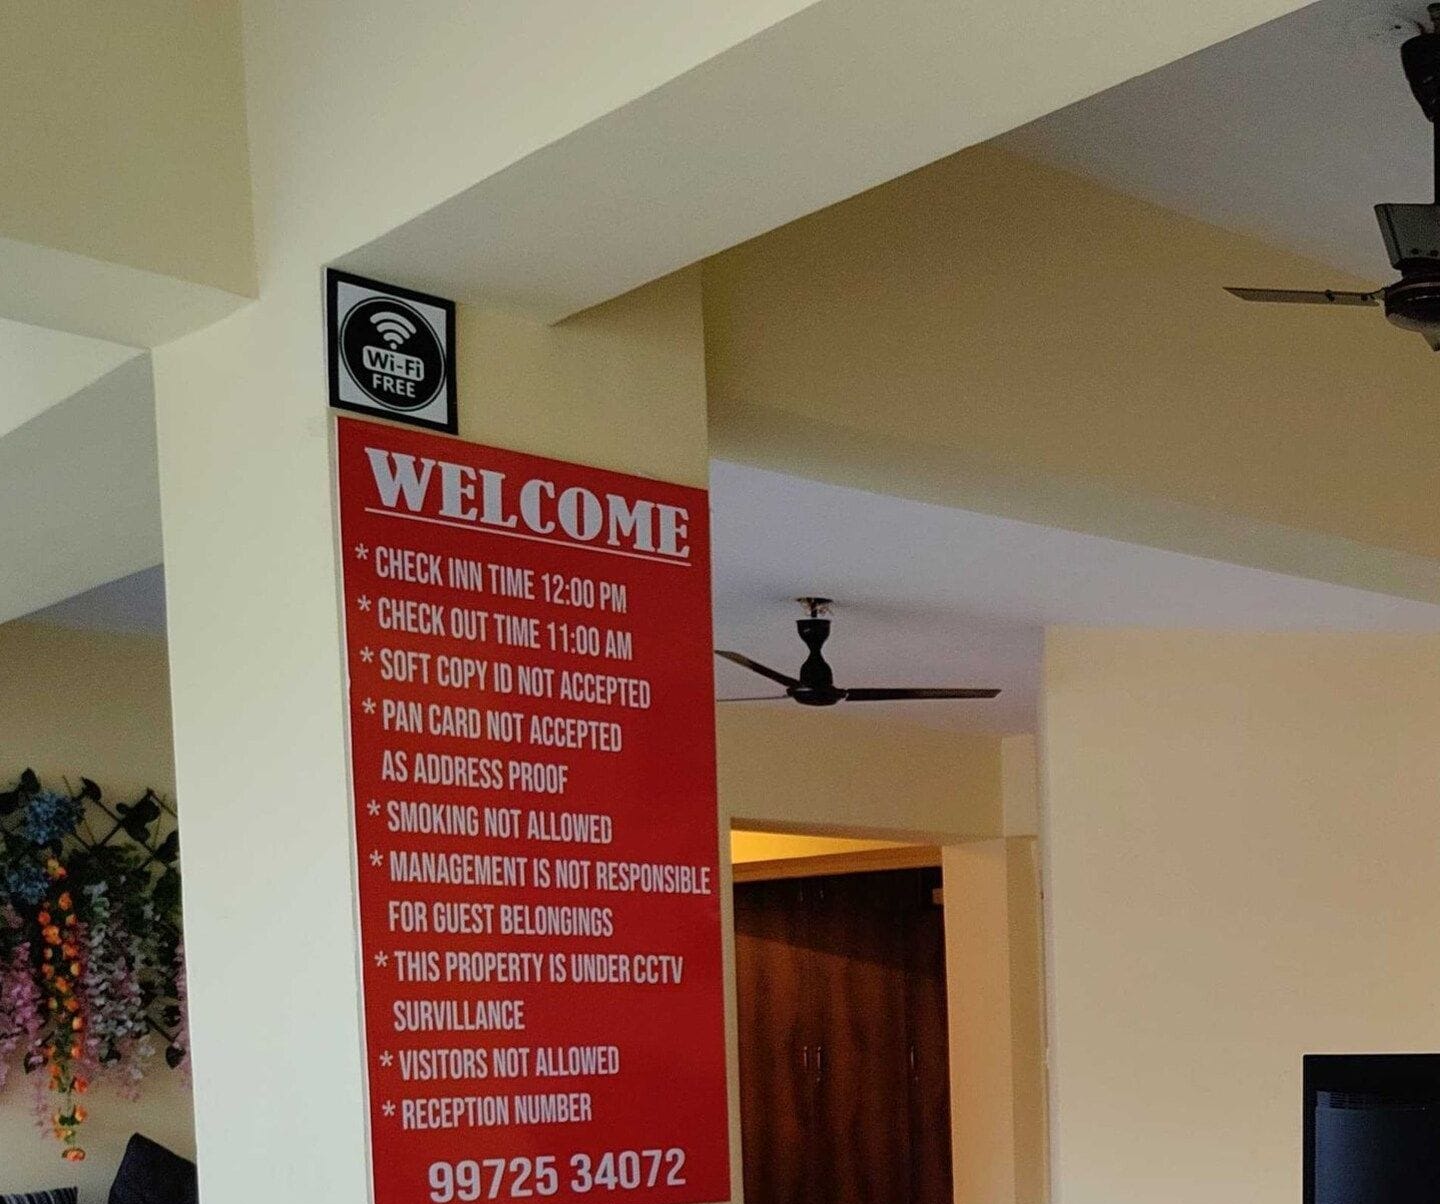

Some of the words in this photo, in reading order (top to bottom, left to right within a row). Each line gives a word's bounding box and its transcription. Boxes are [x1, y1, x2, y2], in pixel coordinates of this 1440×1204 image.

[367, 349, 421, 378] Wi-Fi
[373, 373, 416, 398] FREE
[365, 447, 689, 557] WELCOME
[376, 546, 443, 585] CHECK
[449, 558, 482, 591] INN
[488, 564, 535, 599] TIME
[542, 574, 594, 609] 12:00
[600, 582, 626, 613] PM
[378, 597, 445, 636] CHECK
[451, 608, 488, 641] OUT
[494, 614, 540, 648] TIME
[548, 622, 600, 656] 11:00
[606, 630, 632, 660] AM
[380, 648, 430, 683] SOFT
[437, 656, 487, 689] COPY
[494, 662, 512, 693] ID
[518, 666, 554, 697] NOT
[561, 671, 650, 708] ACCEPTED
[383, 699, 422, 733] PAN
[429, 704, 481, 738] CARD
[487, 710, 524, 742] NOT
[530, 715, 621, 751] ACCEPTED
[382, 750, 408, 781] AS
[414, 753, 503, 789] ADDRESS
[509, 761, 568, 793] PROOF
[387, 801, 478, 836] SMOKING
[484, 808, 521, 838] NOT
[528, 811, 612, 843] ALLOWED
[390, 851, 527, 886] MANAGEMENT
[533, 858, 550, 888] IS
[556, 859, 590, 889] NOT
[596, 862, 710, 894] RESPONSIBLE
[389, 901, 427, 932] FOR
[433, 902, 494, 933] GUEST
[500, 905, 613, 936] BELONGINGS
[394, 951, 440, 981] THIS
[446, 952, 543, 982] PROPERTY
[549, 953, 566, 982] IS
[571, 954, 630, 982] UNDER
[634, 955, 683, 983] CCTV
[393, 1000, 525, 1031] SURVILLANCE
[399, 1049, 488, 1080] VISITORS
[493, 1048, 529, 1077] NOT
[536, 1046, 619, 1076] ALLOWED
[402, 1096, 509, 1130] RECEPTION
[515, 1093, 591, 1124] NUMBER
[429, 1156, 558, 1203] 99725
[571, 1148, 685, 1192] 34072
